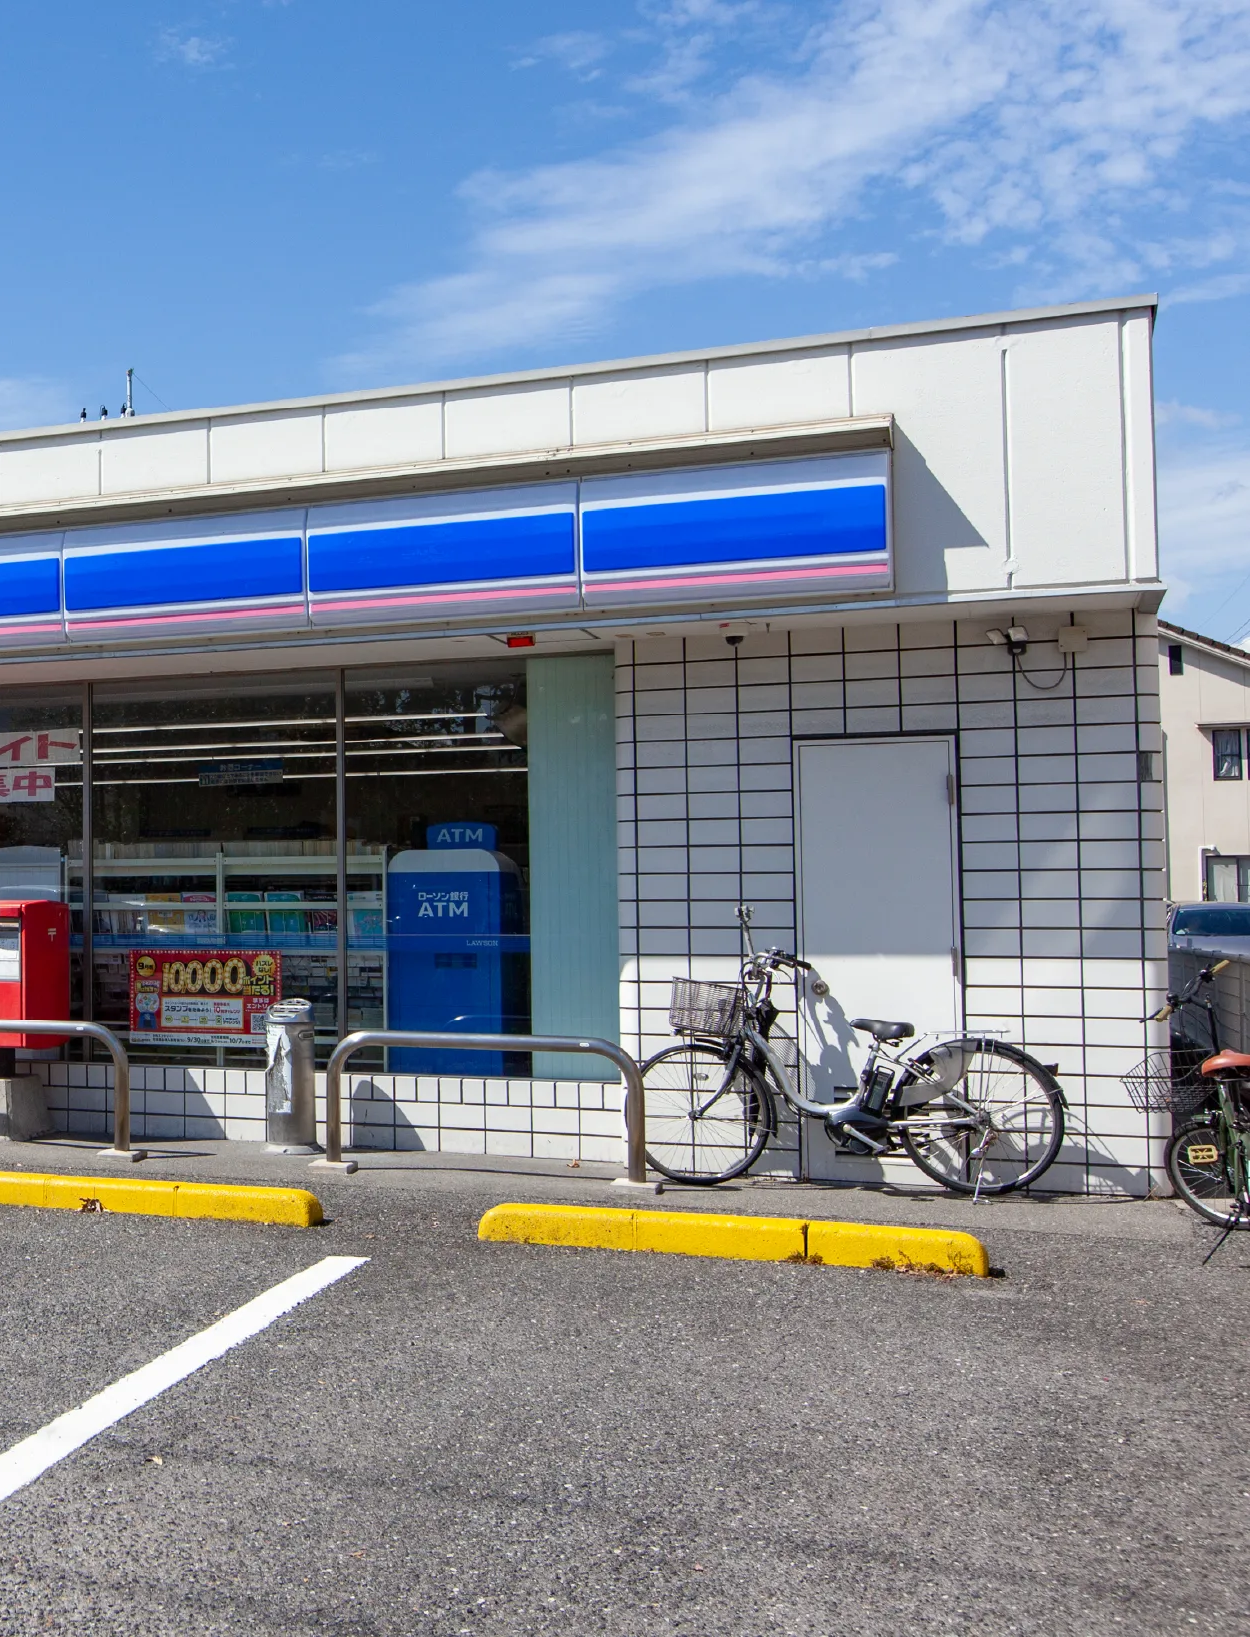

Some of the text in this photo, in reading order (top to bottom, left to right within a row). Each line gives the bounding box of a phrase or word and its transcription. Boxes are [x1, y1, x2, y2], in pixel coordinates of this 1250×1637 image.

[436, 828, 483, 842] ATM
[418, 892, 468, 901] ローソン銀行
[418, 902, 468, 917] ATM
[162, 957, 247, 993] 10,000
[242, 975, 275, 985] ポイント
[242, 985, 275, 996] 当たる!
